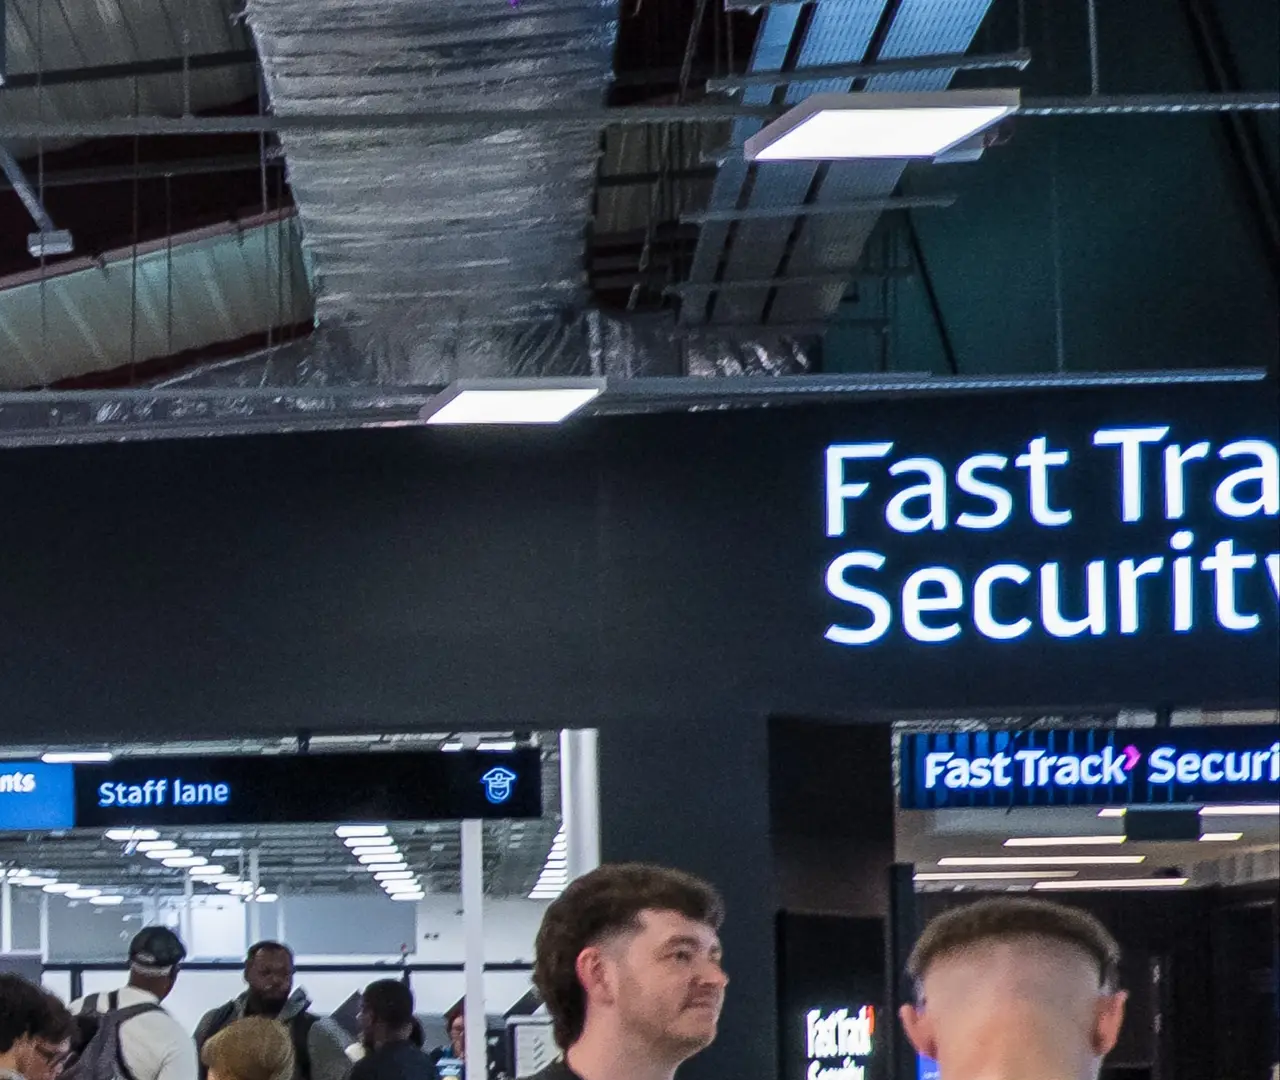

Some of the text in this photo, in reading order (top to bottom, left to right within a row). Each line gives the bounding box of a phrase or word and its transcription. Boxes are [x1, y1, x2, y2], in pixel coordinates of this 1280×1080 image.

[824, 425, 1280, 538] Fast Tra
[923, 738, 1280, 790] Fast Track Securi
[99, 777, 230, 806] Staff lane
